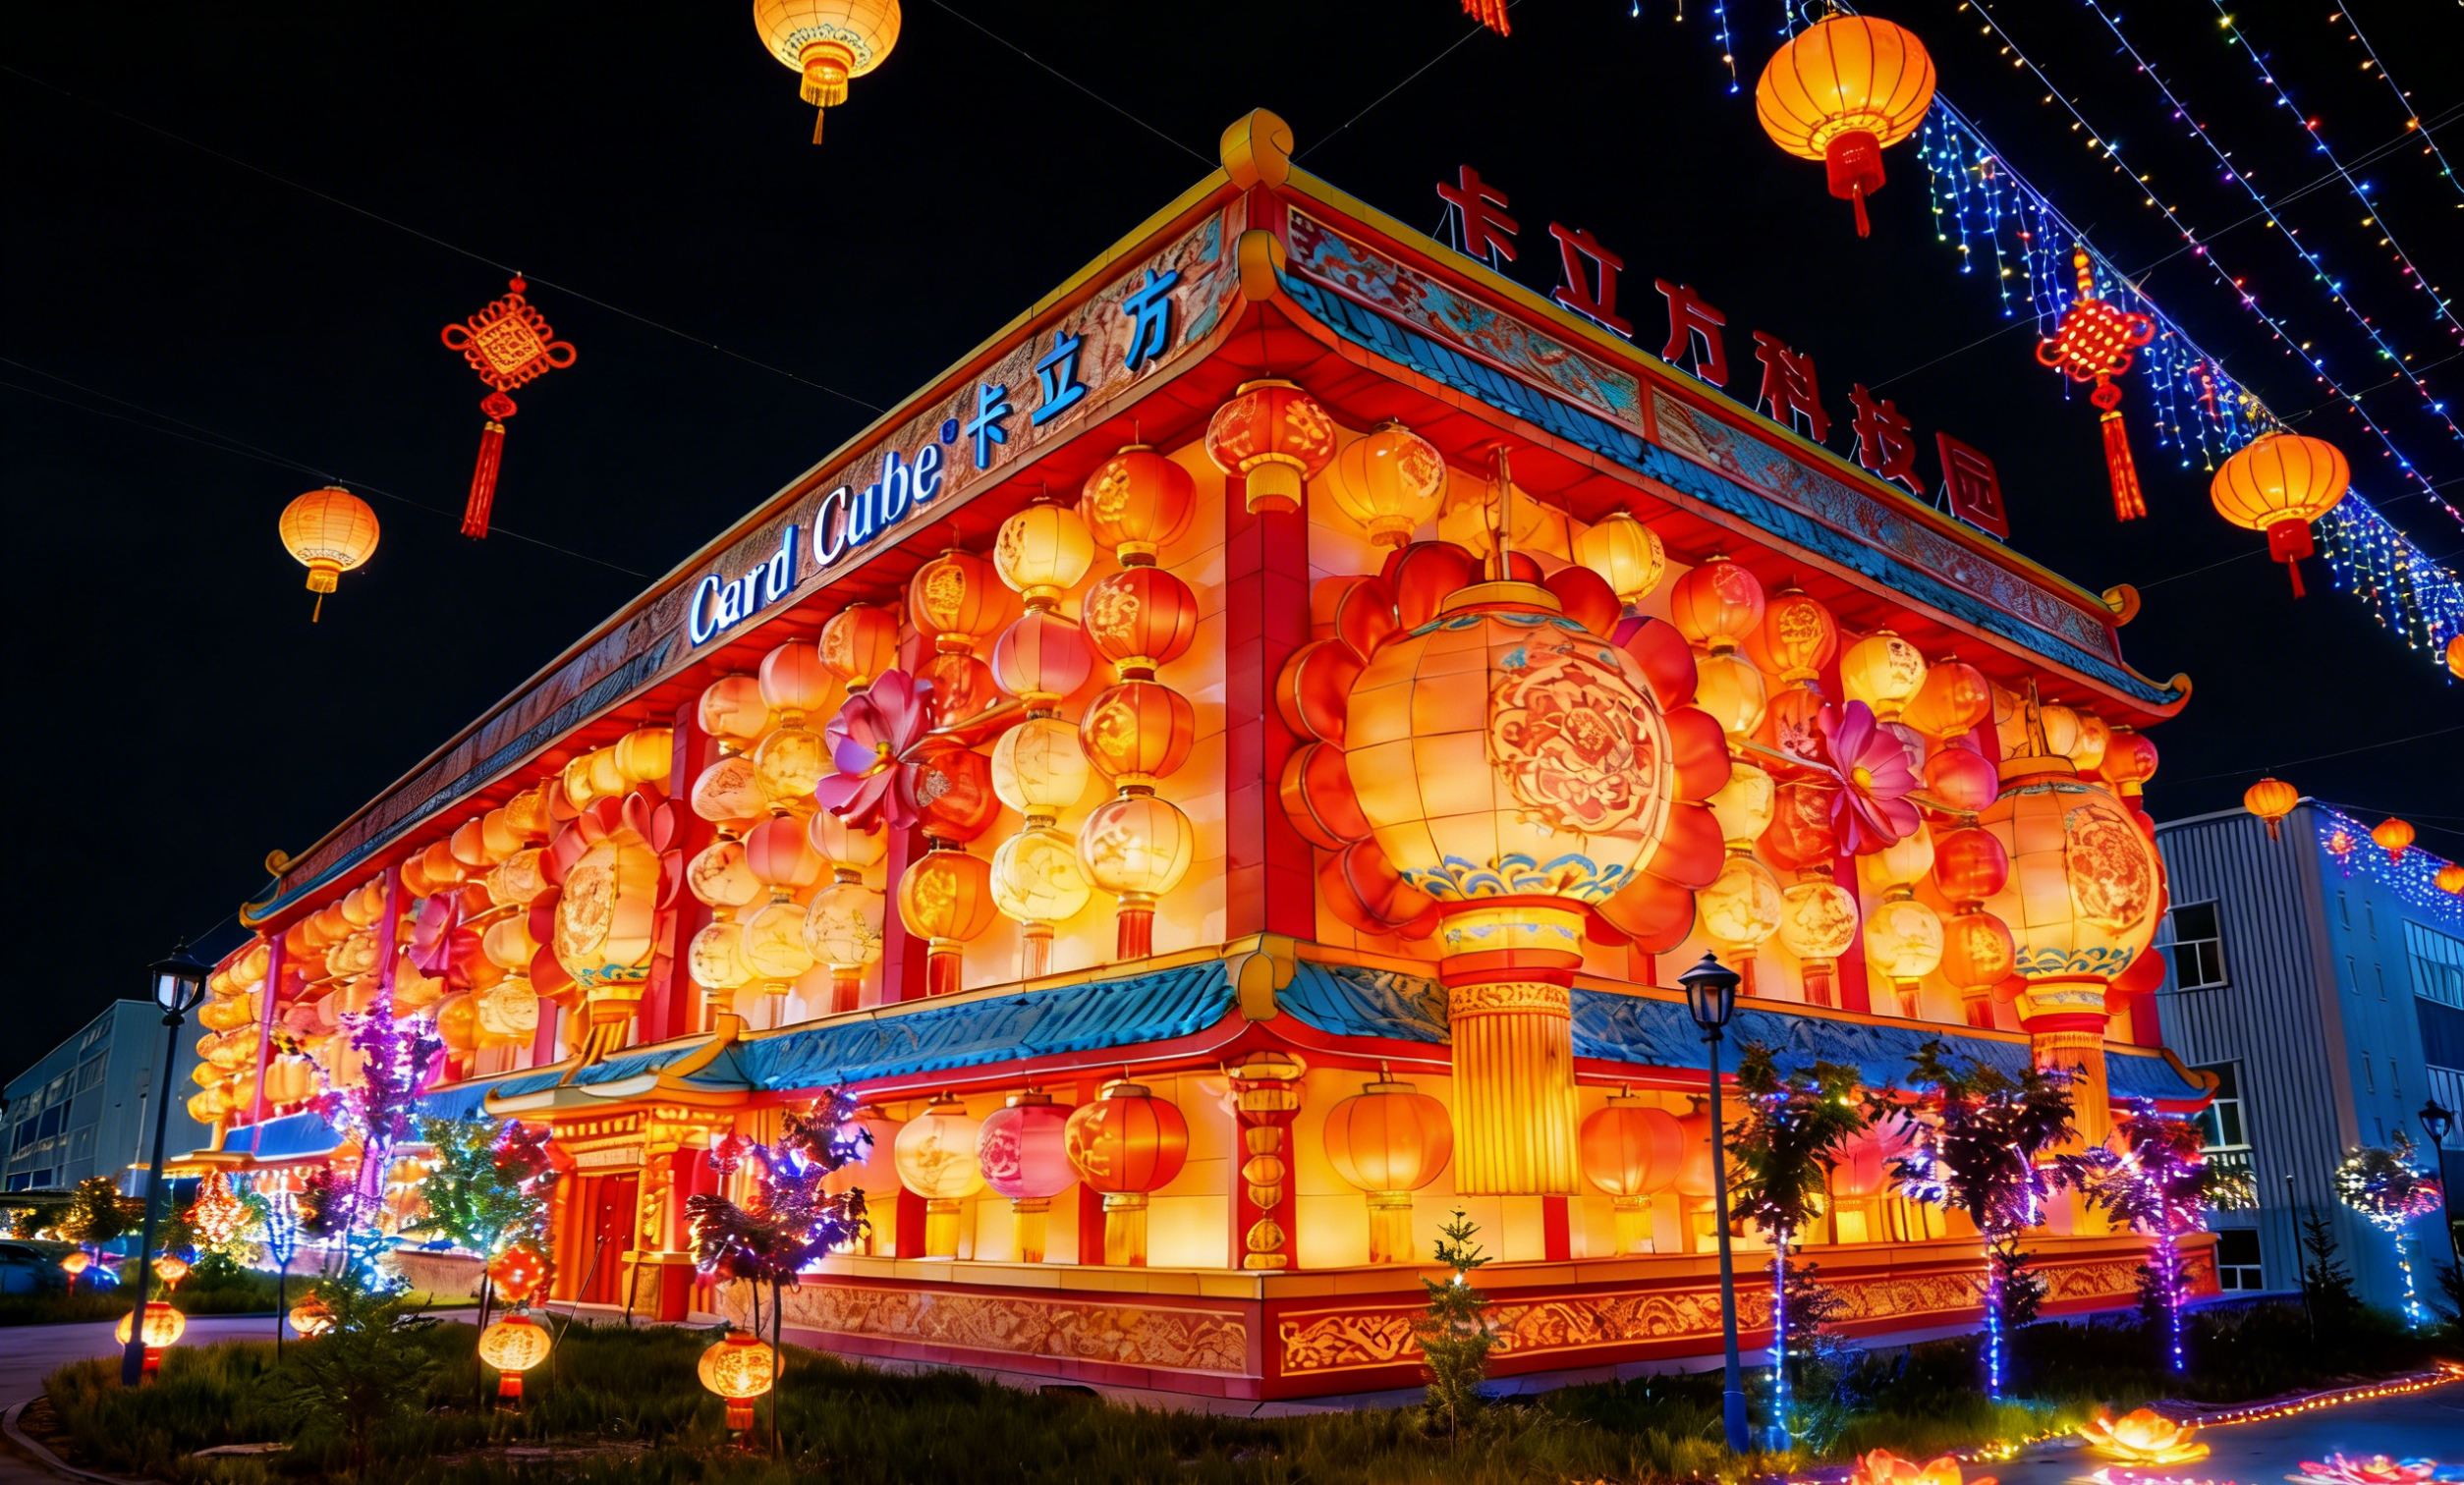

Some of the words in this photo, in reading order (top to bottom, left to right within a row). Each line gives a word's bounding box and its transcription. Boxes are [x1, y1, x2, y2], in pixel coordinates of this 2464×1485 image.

[690, 524, 798, 647] Card
[967, 268, 1178, 469] 卡立方
[1436, 164, 2011, 542] 卡立方科技园
